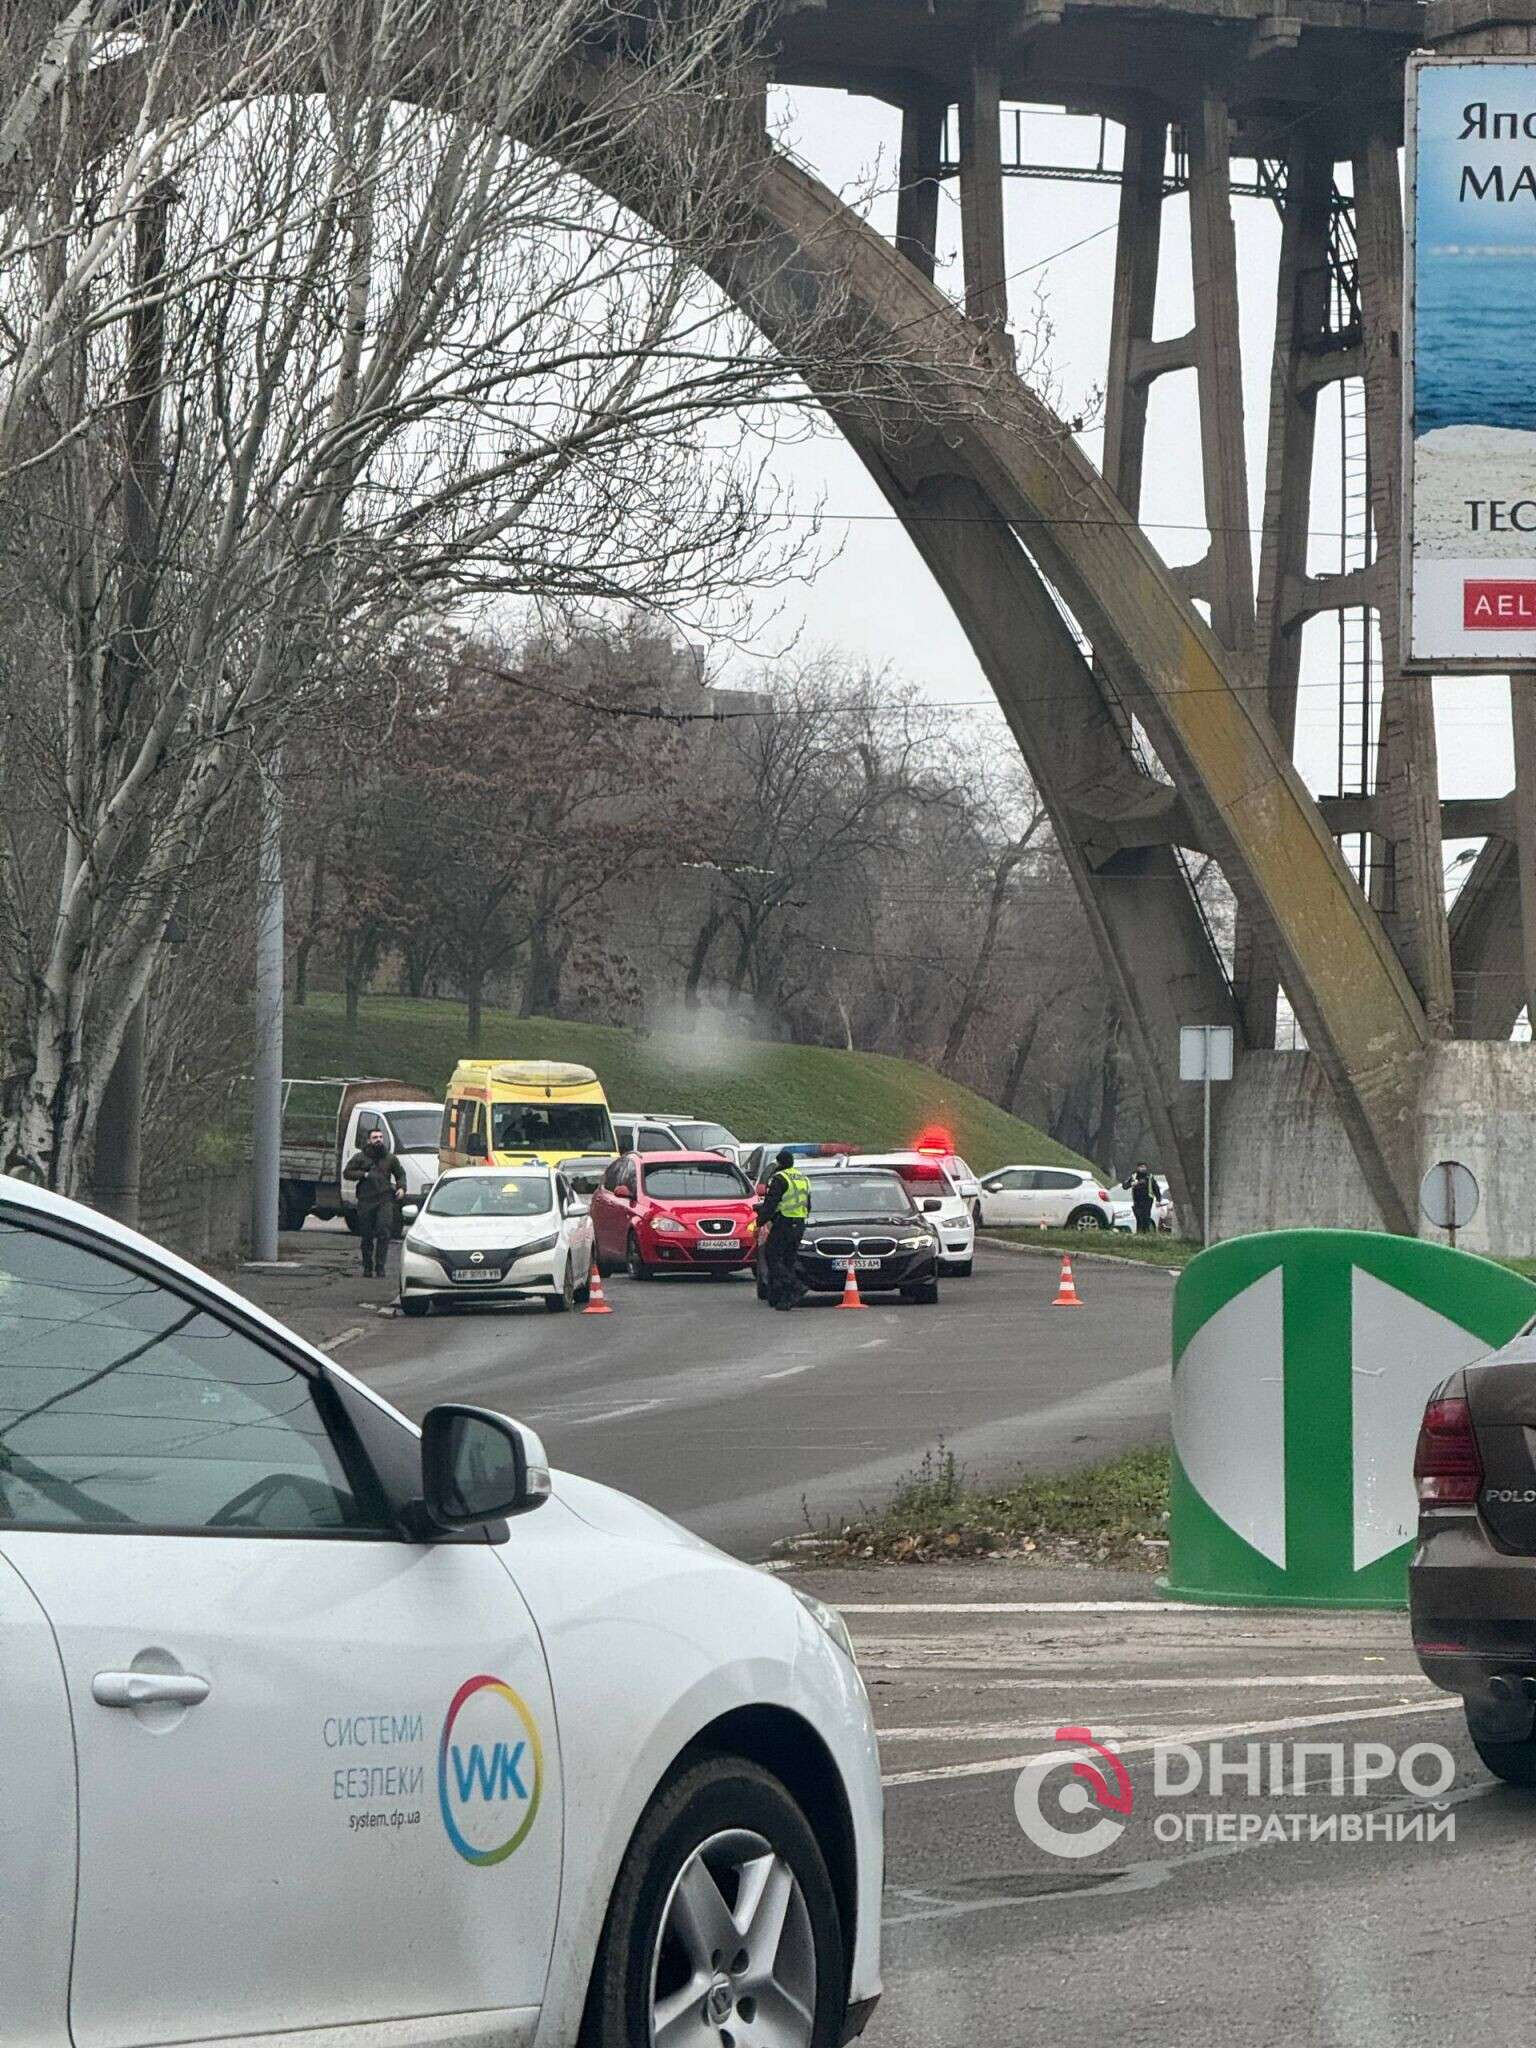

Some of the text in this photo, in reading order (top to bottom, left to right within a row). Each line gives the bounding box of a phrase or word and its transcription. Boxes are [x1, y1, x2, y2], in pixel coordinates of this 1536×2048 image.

[1486, 1489, 1536, 1502] POLO
[323, 1712, 424, 1748] СИСТЕМИ
[333, 1766, 424, 1800] БЕЗПЕКИ
[450, 1741, 529, 1803] WK
[349, 1809, 421, 1832] system.dp.ua
